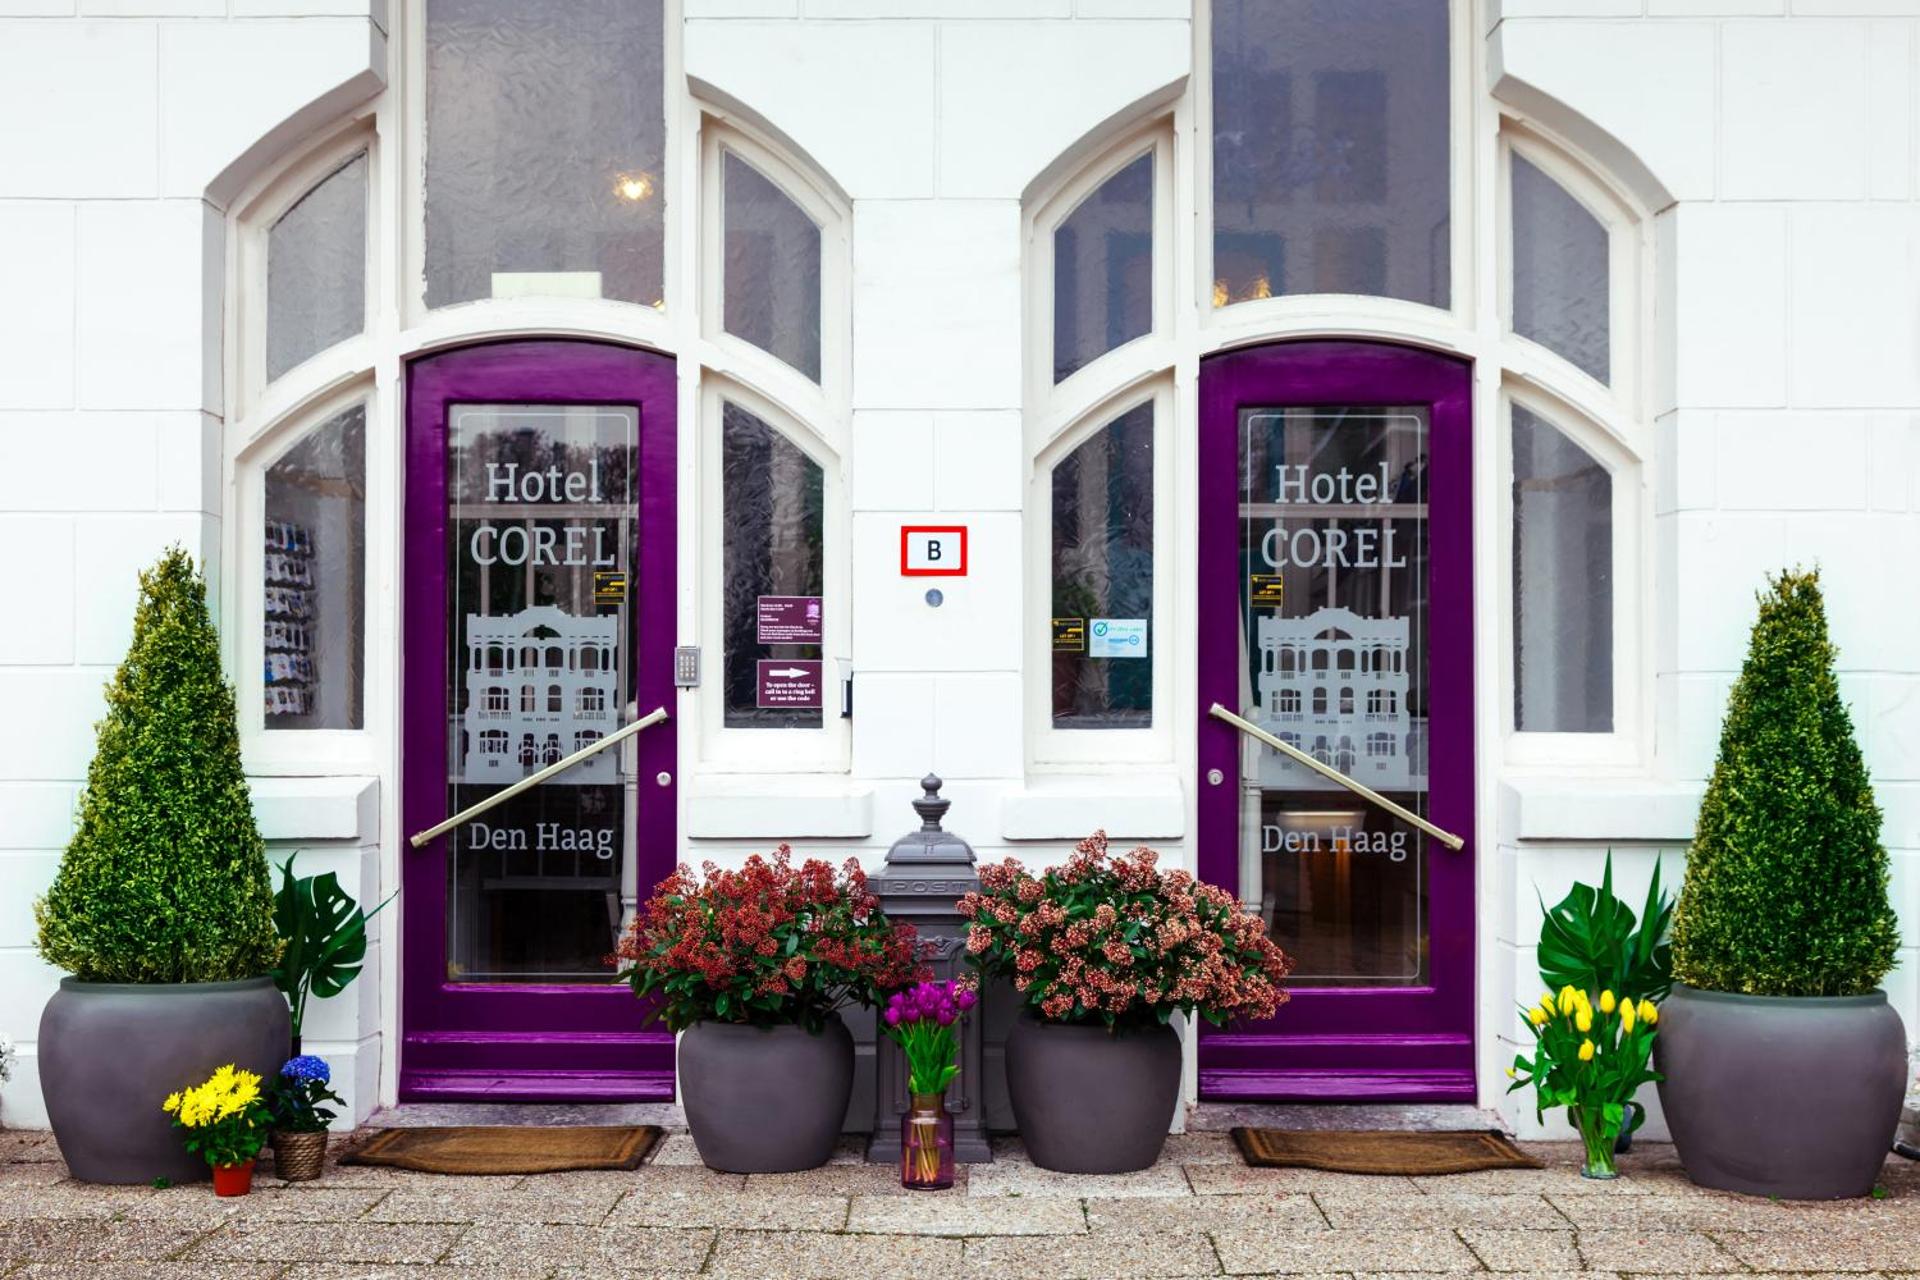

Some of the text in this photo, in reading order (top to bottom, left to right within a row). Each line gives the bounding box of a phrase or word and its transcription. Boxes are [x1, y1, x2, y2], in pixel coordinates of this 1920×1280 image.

[484, 459, 603, 502] Hotel
[1275, 461, 1393, 504] Hotel
[470, 526, 615, 566] COREL
[927, 539, 942, 561] B
[1261, 528, 1406, 568] COREL
[468, 822, 614, 860] Den Haag
[1262, 825, 1408, 862] Den Haag
[893, 881, 968, 893] POST
